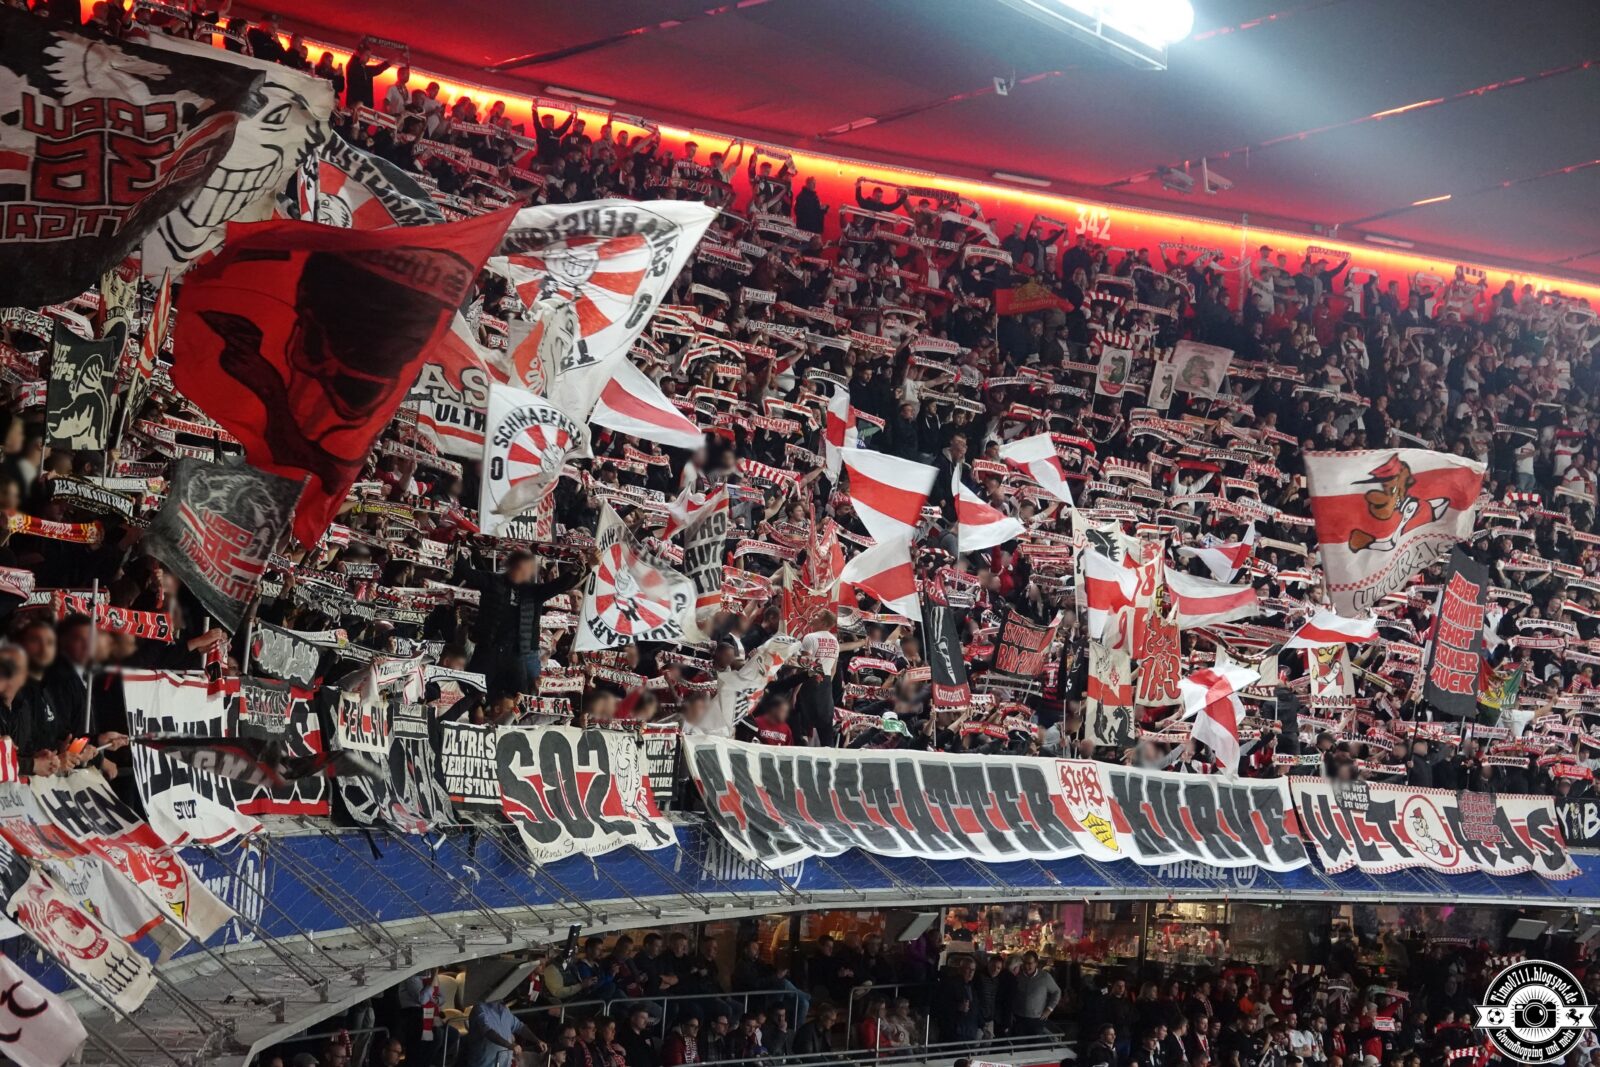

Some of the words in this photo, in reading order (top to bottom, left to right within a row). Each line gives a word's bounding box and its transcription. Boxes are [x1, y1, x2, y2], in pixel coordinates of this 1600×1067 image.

[1074, 206, 1112, 241] 342
[435, 404, 487, 433] ULTR
[494, 406, 583, 449] SCHWABENS
[1449, 570, 1480, 604] JEDER
[1442, 589, 1485, 631] RBANNTE
[1434, 641, 1480, 673] ARKER
[442, 727, 496, 760] ULTRAS
[695, 742, 1087, 860] CANNSTATTER
[1108, 769, 1310, 866] KURVE
[701, 836, 776, 881] Allian
